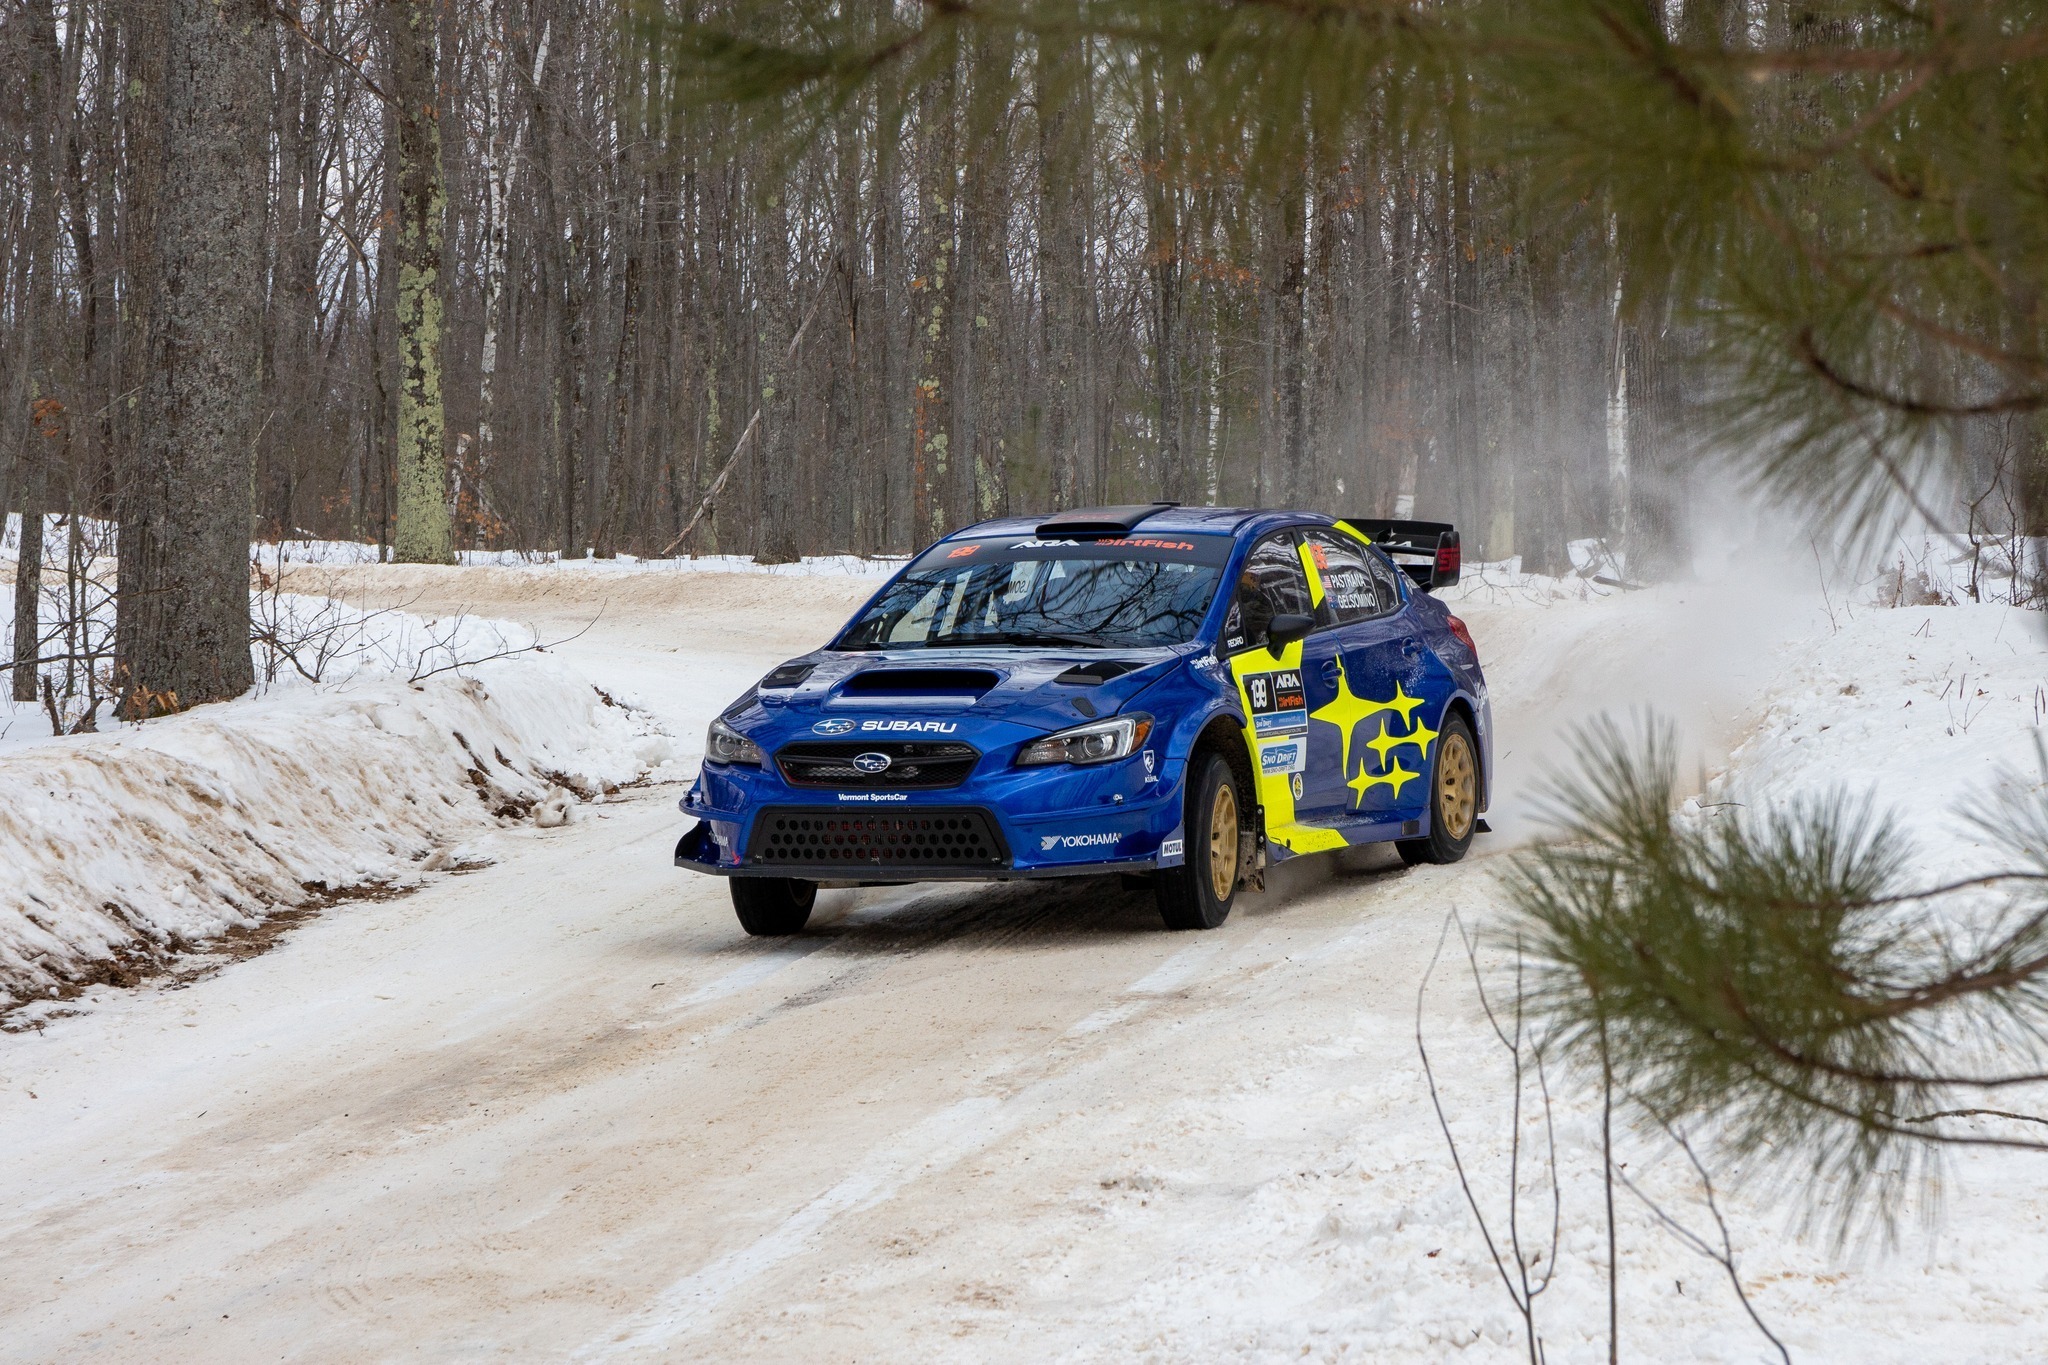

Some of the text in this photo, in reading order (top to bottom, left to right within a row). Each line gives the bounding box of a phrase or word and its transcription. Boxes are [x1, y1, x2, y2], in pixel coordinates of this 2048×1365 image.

[1010, 539, 1080, 549] ARA
[1330, 573, 1366, 589] PASTRANA
[1337, 592, 1376, 609] GELSOMINO
[1276, 673, 1301, 689] ARA
[1251, 679, 1267, 708] 199
[861, 720, 957, 733] SUBARU
[1262, 755, 1276, 766] SNO
[1276, 752, 1296, 764] DRIFT
[838, 793, 907, 802] Vermont SportsCar
[1061, 833, 1120, 847] YOKOHAMA
[1163, 841, 1182, 854] MOTUL
